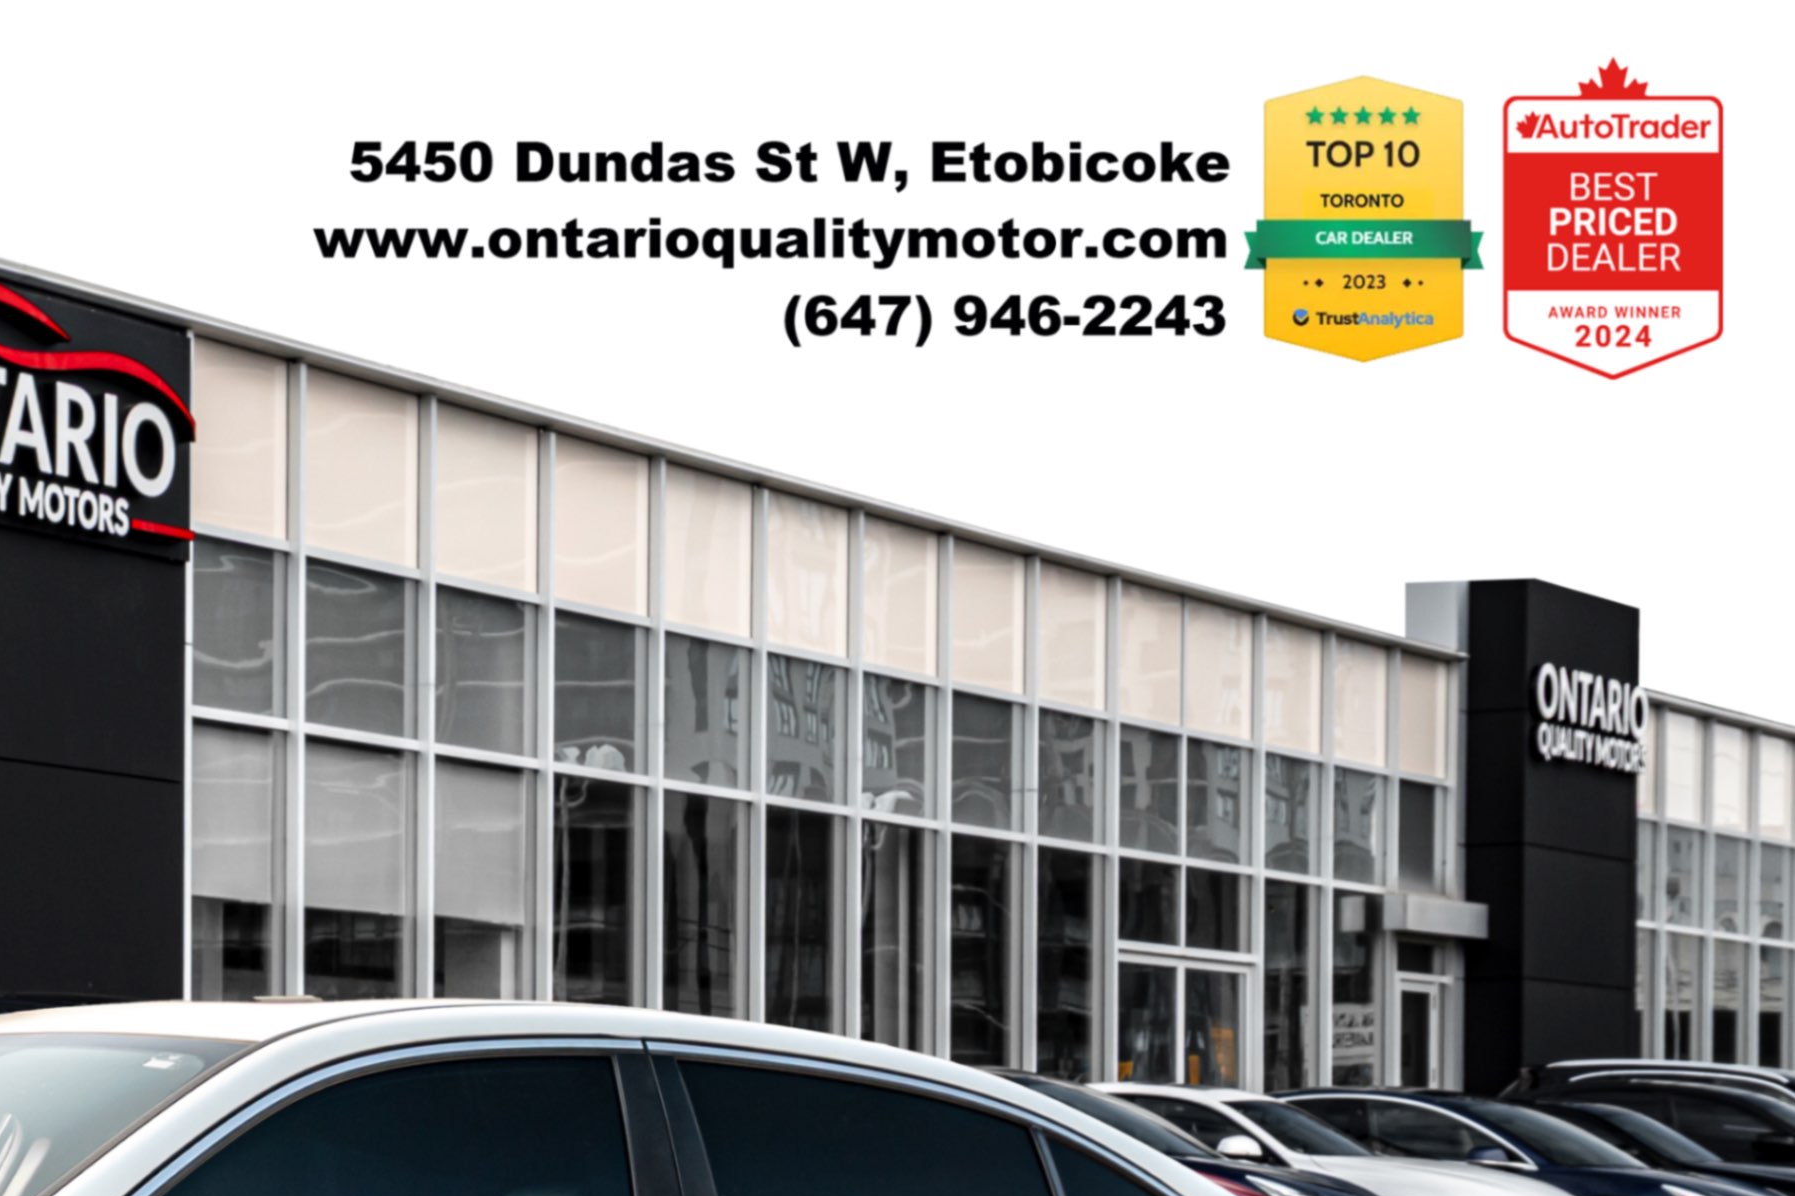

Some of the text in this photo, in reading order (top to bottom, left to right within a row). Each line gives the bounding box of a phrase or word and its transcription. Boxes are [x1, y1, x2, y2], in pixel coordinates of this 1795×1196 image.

[19, 476, 130, 537] MOTORS
[1537, 662, 1648, 740] ONTARIO
[1537, 722, 1646, 773] QUALITY MOTORS
